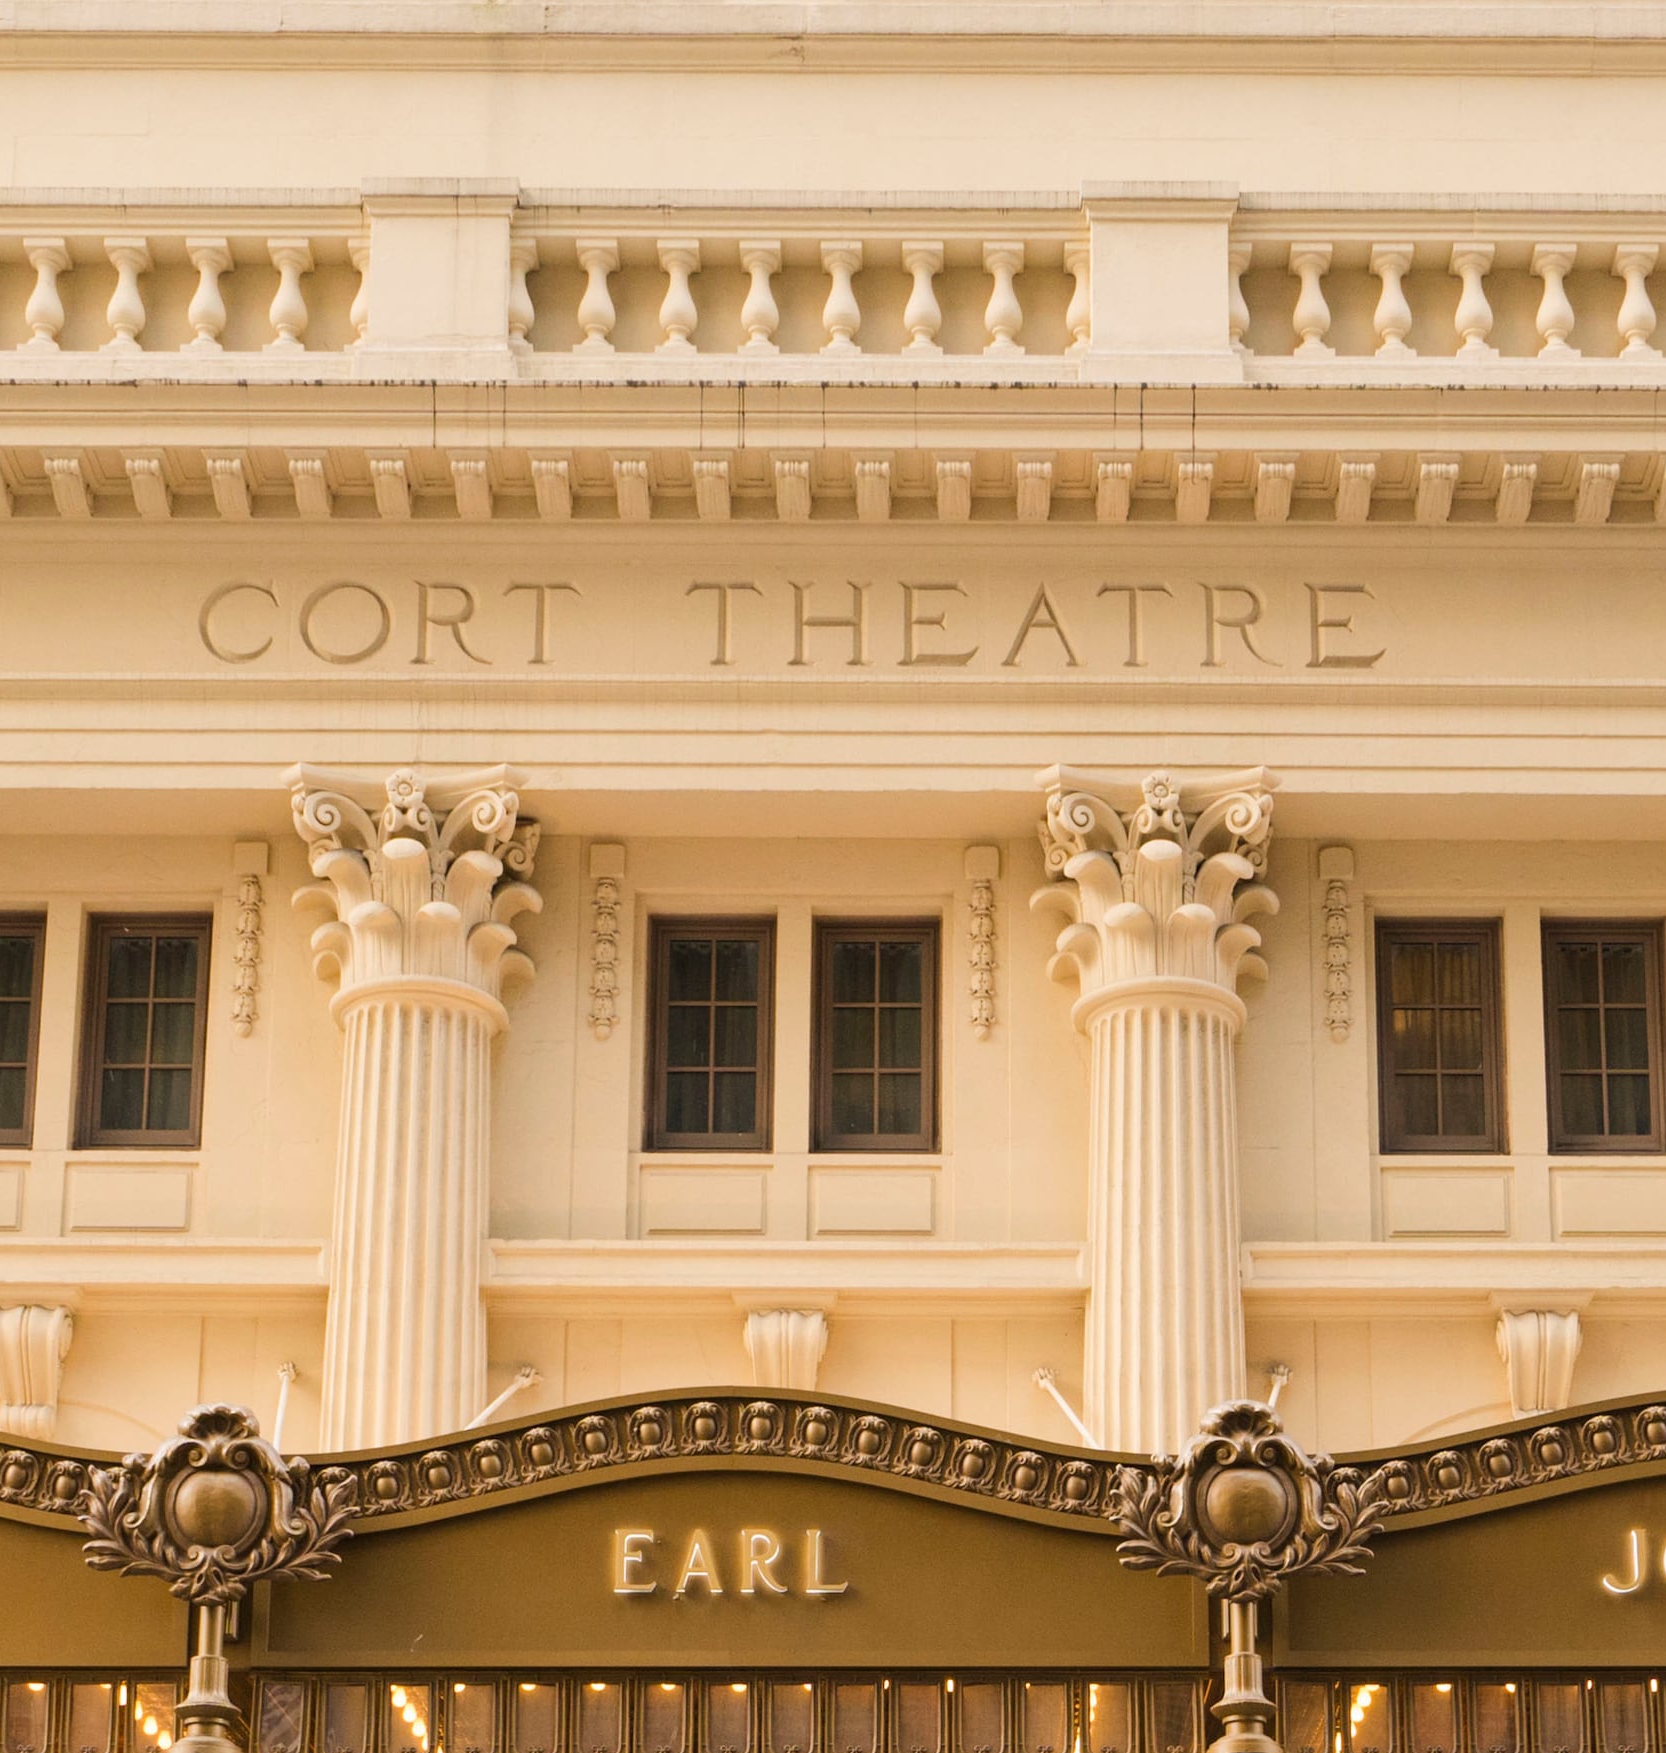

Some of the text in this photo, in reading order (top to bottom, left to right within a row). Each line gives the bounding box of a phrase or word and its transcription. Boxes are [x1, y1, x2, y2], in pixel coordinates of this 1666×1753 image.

[197, 579, 1387, 668] CORT THEATRE
[614, 1529, 848, 1593] EARL
